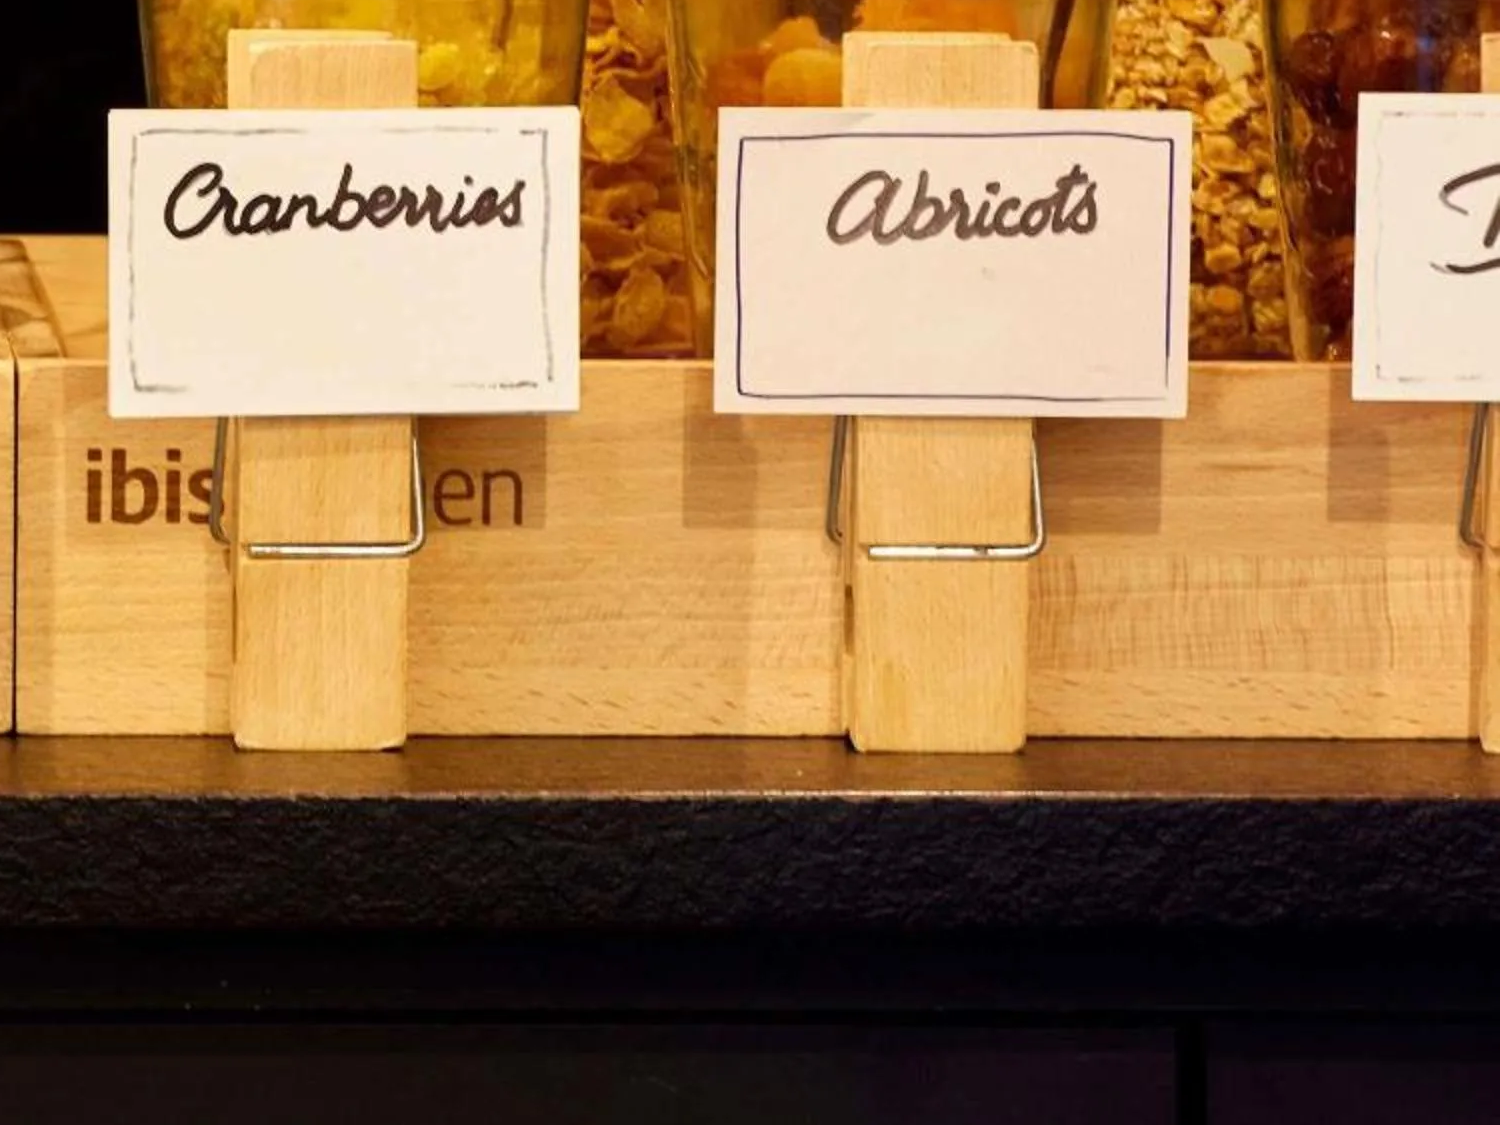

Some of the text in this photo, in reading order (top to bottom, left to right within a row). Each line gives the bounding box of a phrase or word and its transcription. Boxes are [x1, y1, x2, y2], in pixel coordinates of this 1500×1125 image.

[163, 162, 526, 240] Cranberries
[826, 163, 1098, 245] Abricots
[87, 448, 225, 524] ibis
